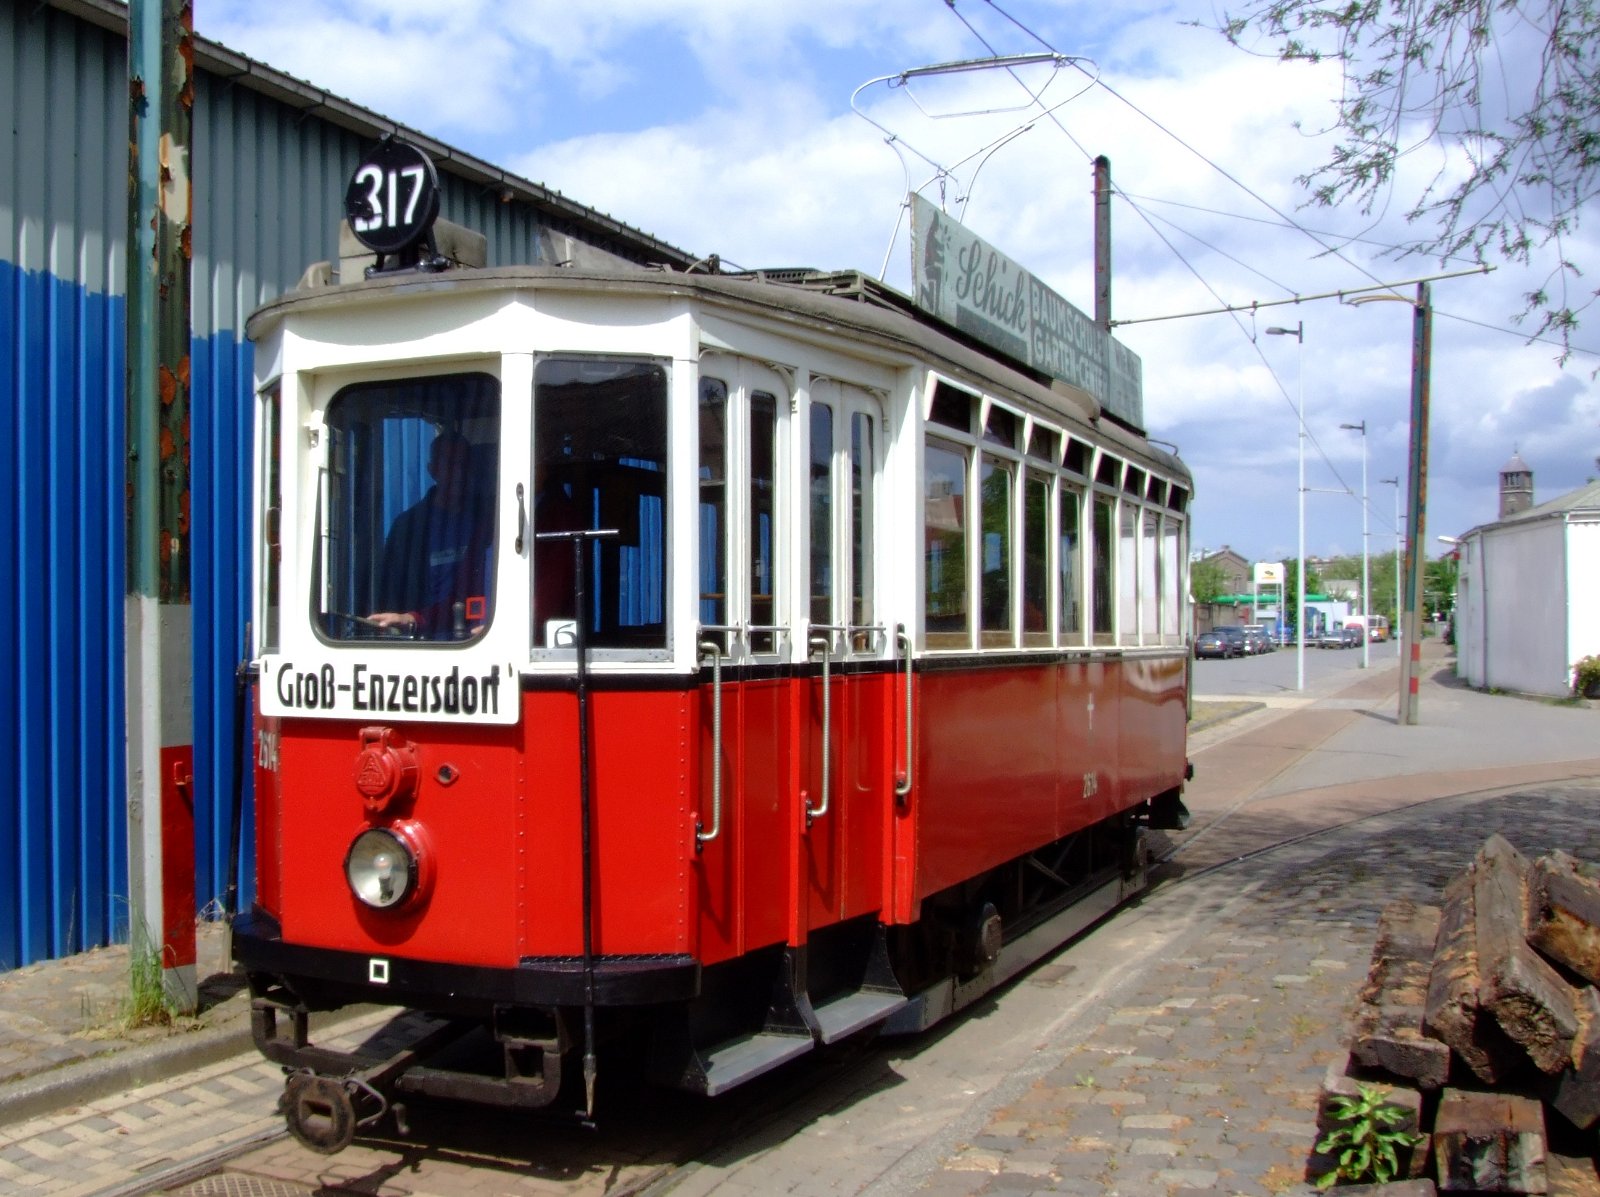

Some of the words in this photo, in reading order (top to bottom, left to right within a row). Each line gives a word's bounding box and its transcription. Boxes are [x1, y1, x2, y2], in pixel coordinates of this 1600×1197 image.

[354, 163, 425, 232] 317
[956, 239, 1027, 333] Schick
[277, 662, 500, 715] Groß-Enzersdorf
[258, 727, 277, 772] 2614
[1083, 771, 1098, 799] 2614
